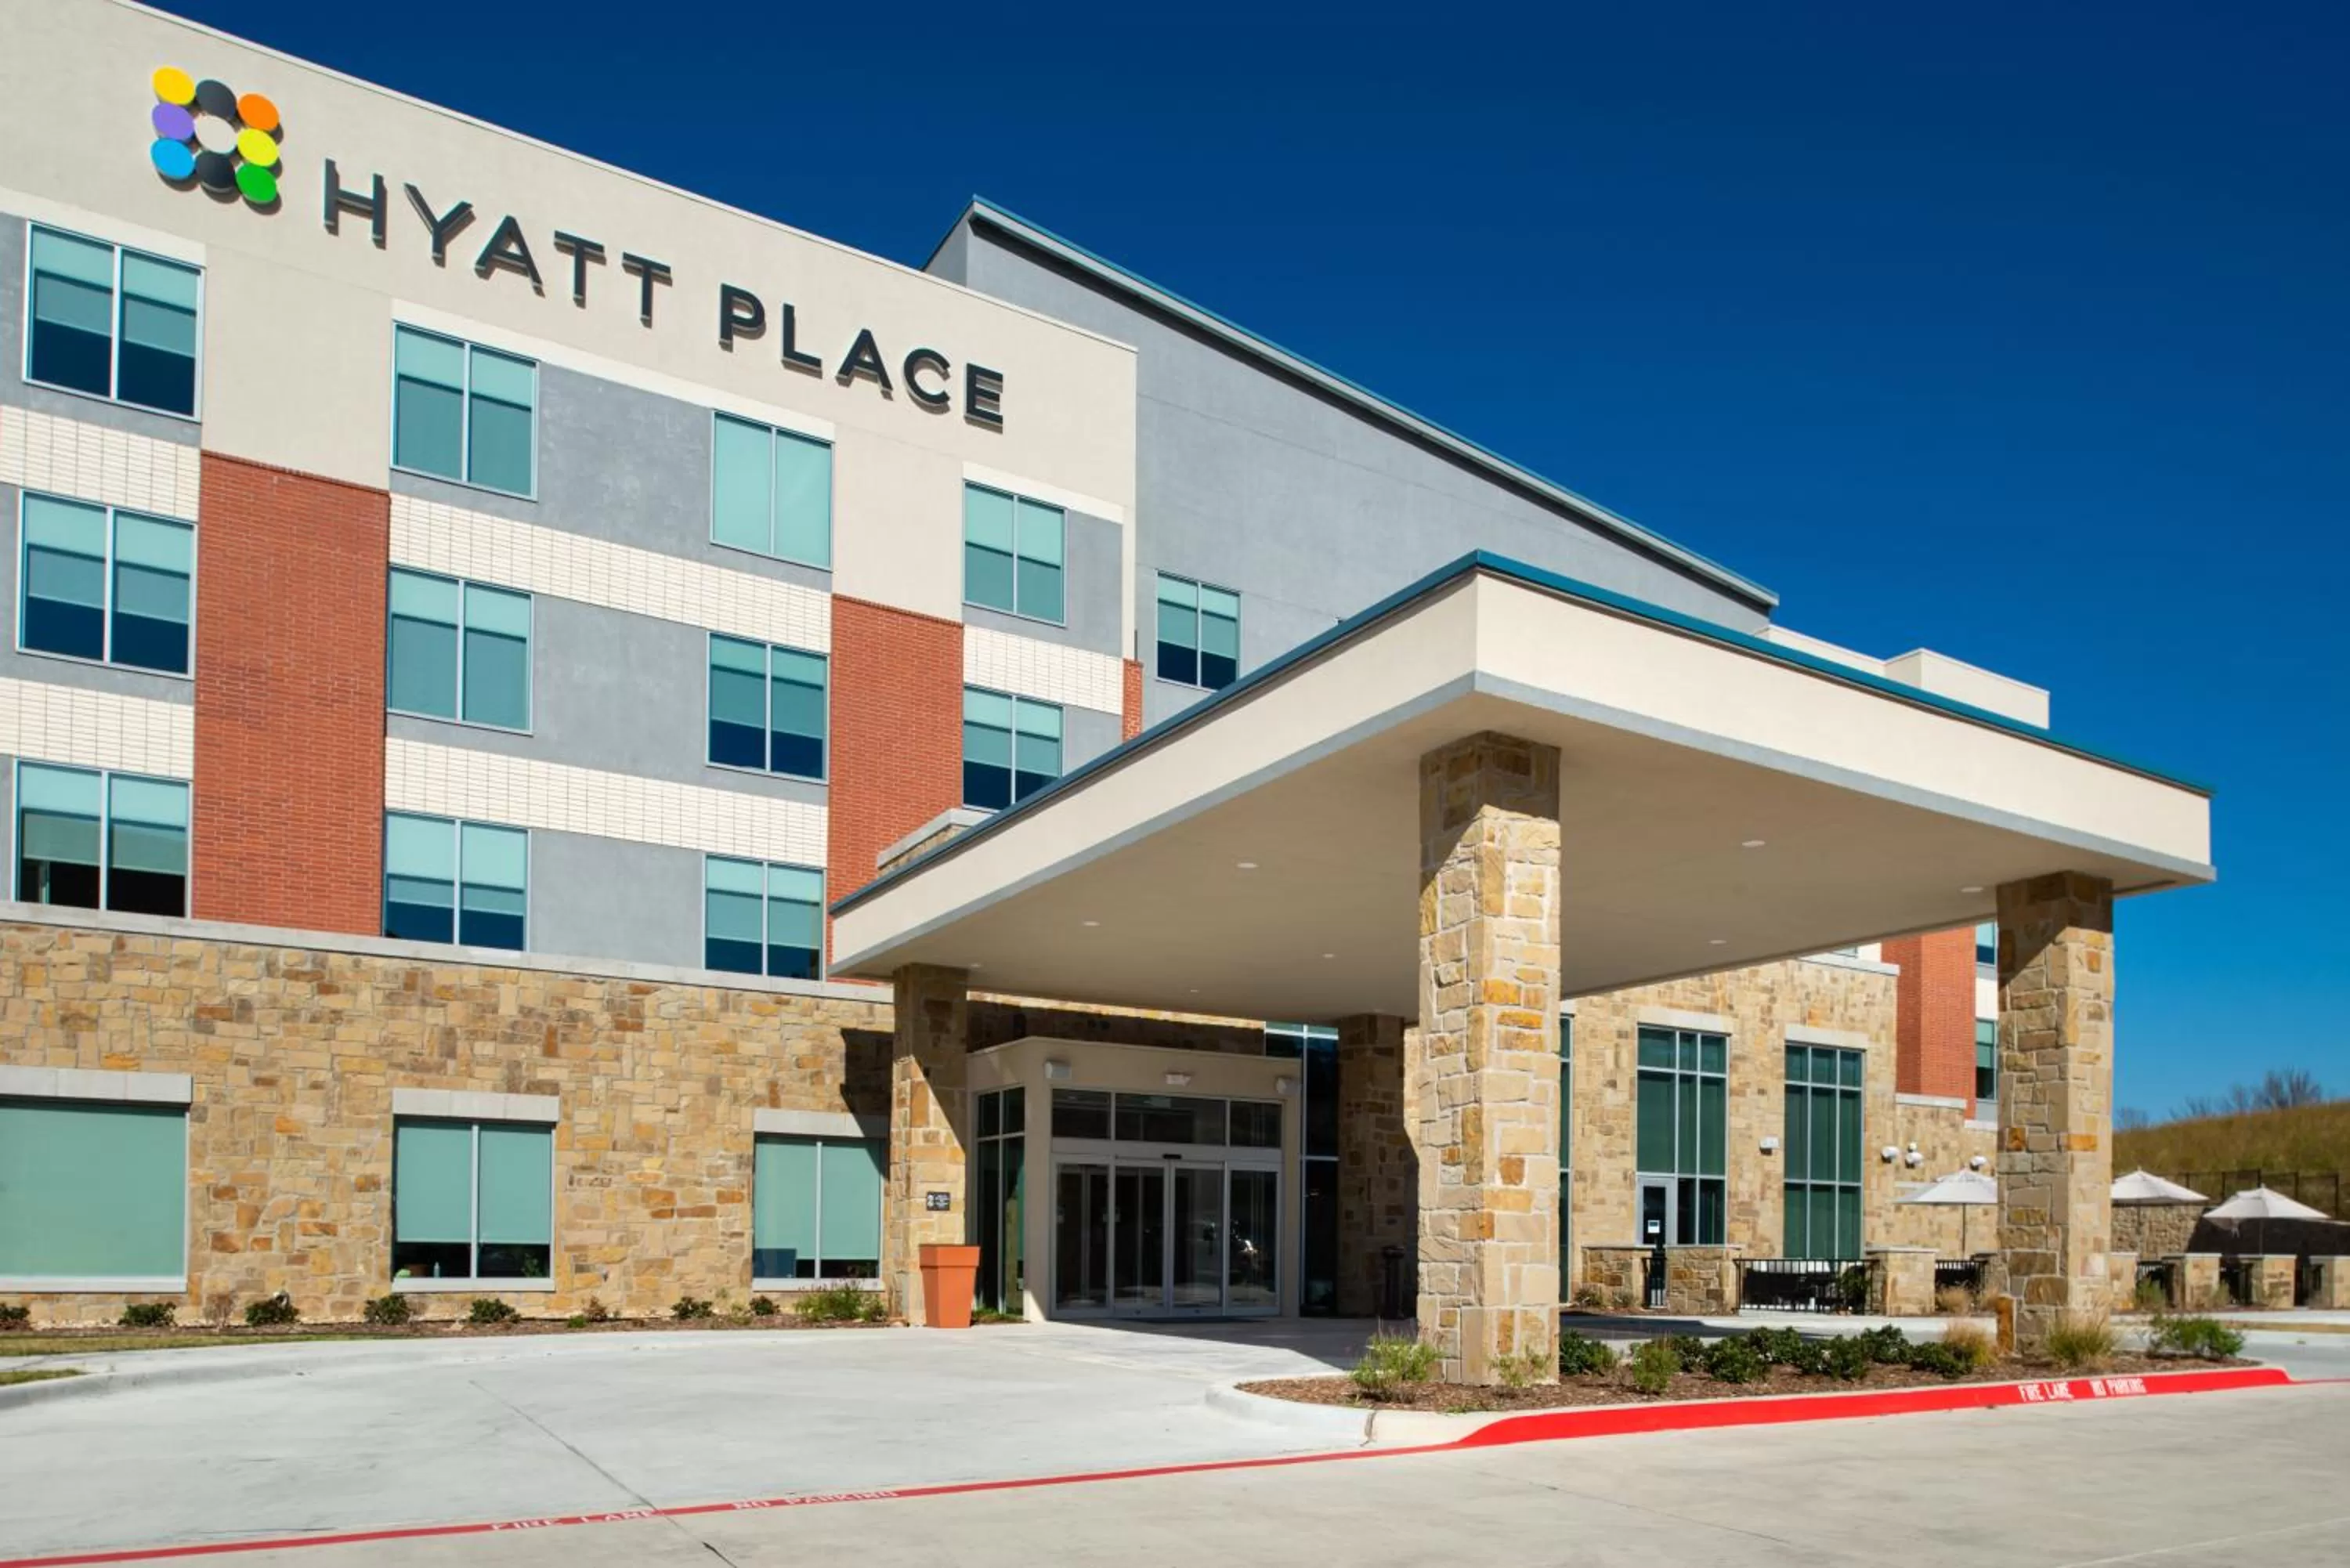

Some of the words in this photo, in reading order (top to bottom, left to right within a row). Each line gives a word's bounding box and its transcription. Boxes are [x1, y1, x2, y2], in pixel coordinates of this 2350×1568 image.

[322, 158, 672, 327] HYATT
[718, 283, 1004, 433] PLACE
[2018, 1383, 2045, 1402] FIRE
[491, 1517, 562, 1530] FIRE
[784, 1490, 899, 1506] PARKING
